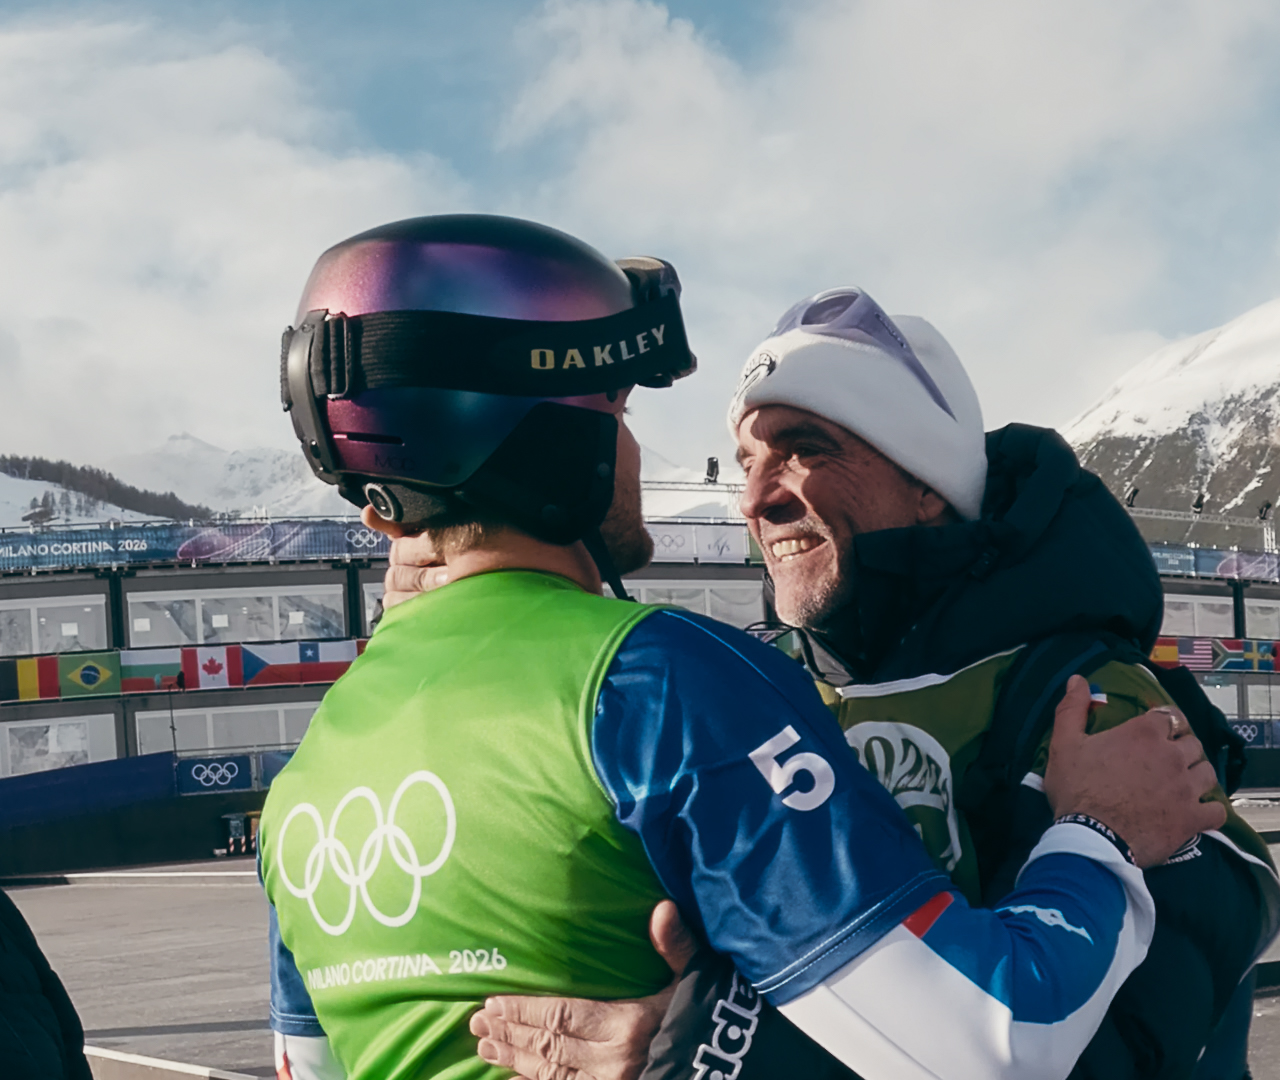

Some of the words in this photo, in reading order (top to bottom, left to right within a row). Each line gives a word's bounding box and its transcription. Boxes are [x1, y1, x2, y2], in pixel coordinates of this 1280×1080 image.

[531, 324, 665, 369] OAKLEY
[50, 541, 114, 556] CORTINA
[119, 539, 148, 551] 2026
[747, 724, 836, 812] 5
[307, 963, 350, 990] MILANO
[352, 953, 443, 984] CORTINA
[449, 948, 508, 974] 2026
